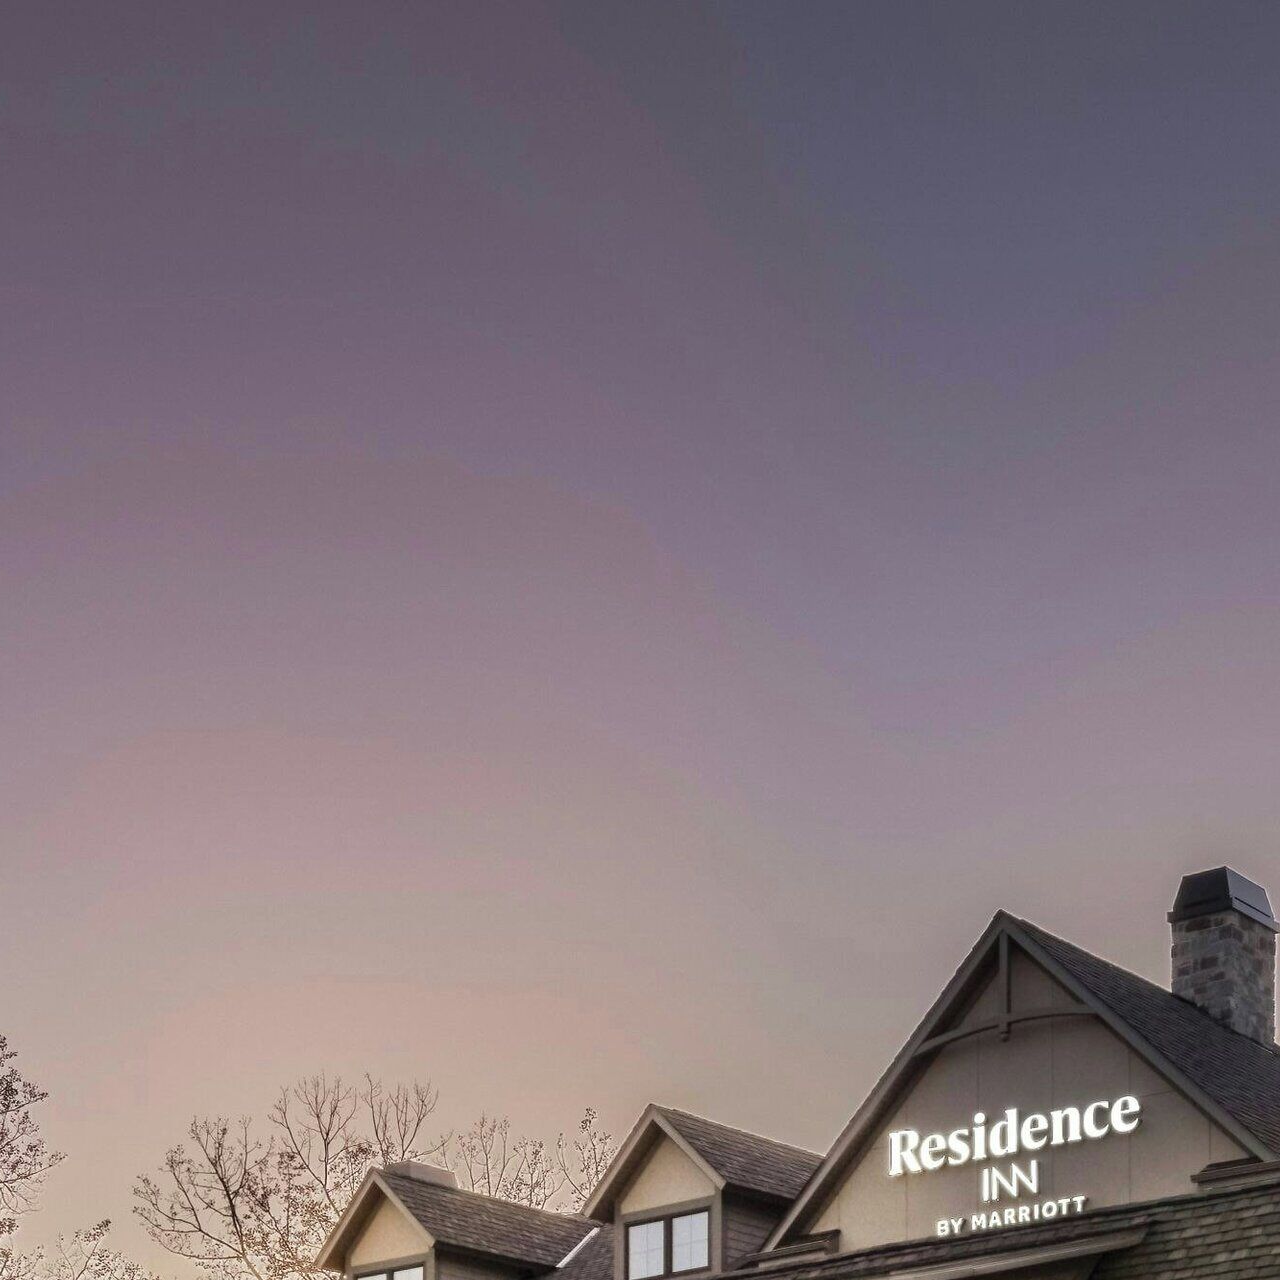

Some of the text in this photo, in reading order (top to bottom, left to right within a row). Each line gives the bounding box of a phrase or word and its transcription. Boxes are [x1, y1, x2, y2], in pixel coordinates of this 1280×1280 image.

[888, 1095, 1141, 1177] Residence
[981, 1159, 1039, 1202] INN
[936, 1196, 1086, 1236] BY MARRIOTT
